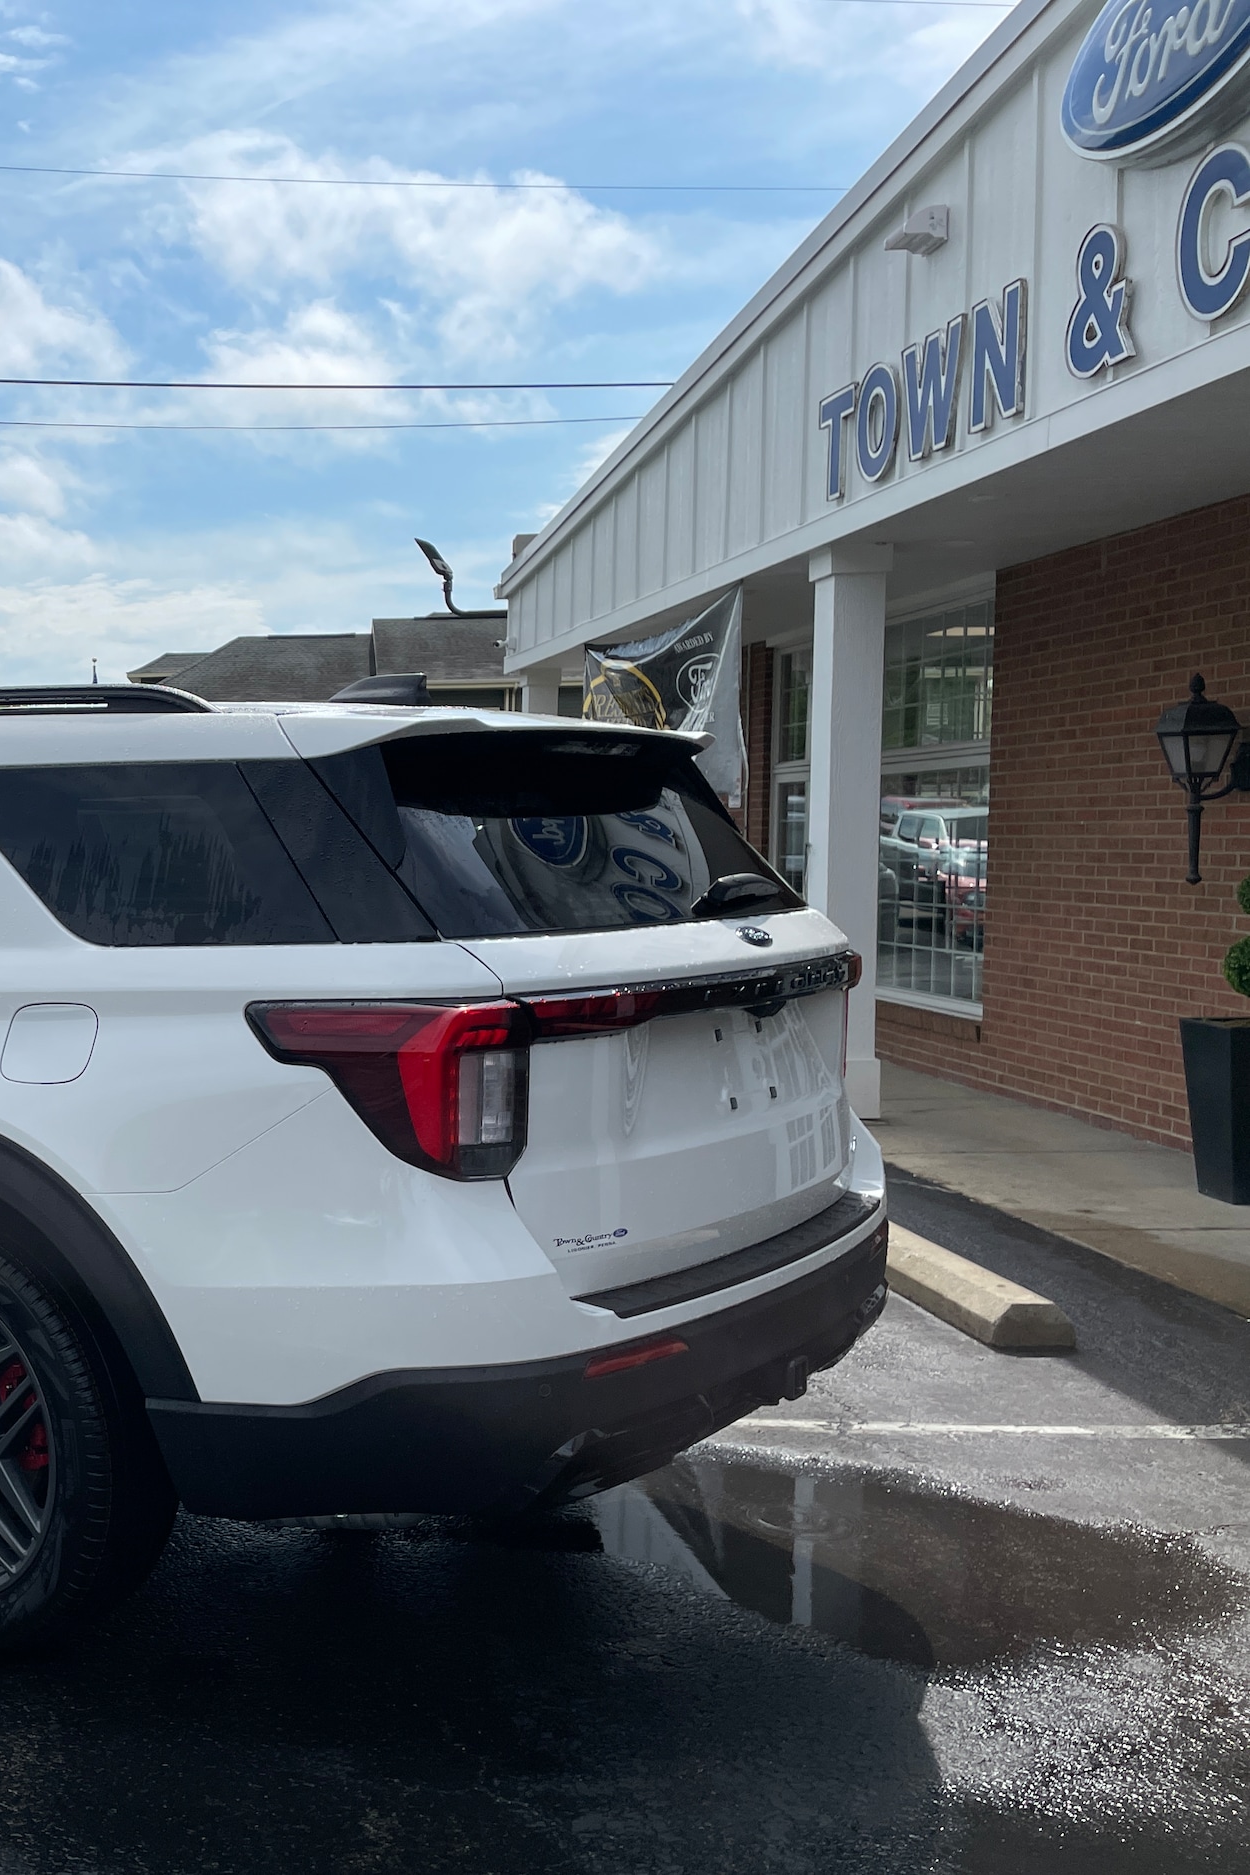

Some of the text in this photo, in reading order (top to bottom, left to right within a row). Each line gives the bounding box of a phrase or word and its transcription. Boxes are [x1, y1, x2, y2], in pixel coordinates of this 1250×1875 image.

[1092, 0, 1237, 124] Ford
[819, 278, 1027, 501] TOWN
[1066, 223, 1136, 379] &
[674, 631, 714, 654] AWARDED BY
[553, 1238, 576, 1247] Town
